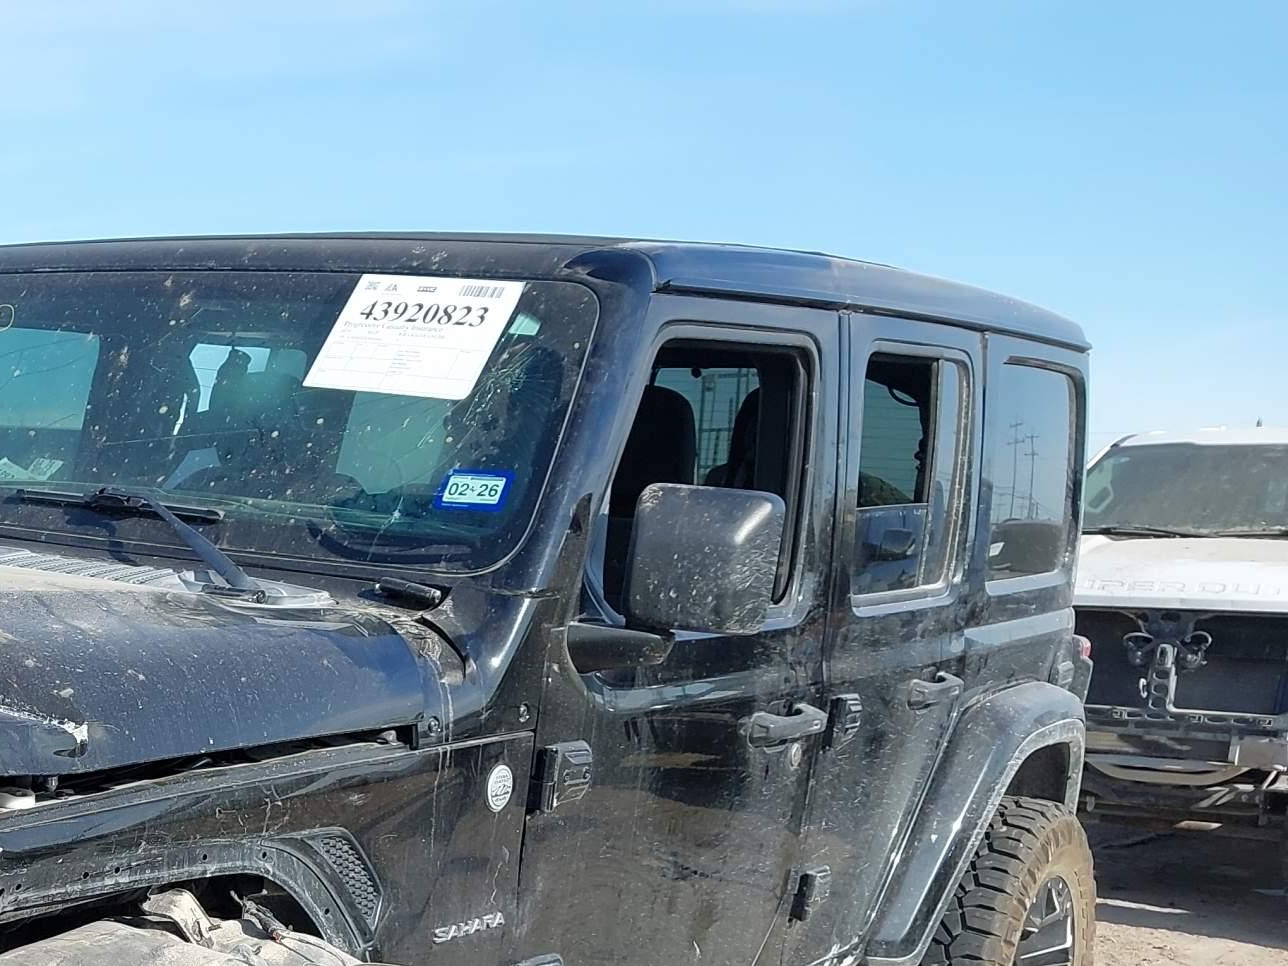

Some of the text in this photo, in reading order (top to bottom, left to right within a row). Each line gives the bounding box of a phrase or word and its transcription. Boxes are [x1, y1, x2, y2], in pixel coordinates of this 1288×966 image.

[359, 300, 489, 327] 43920823
[448, 482, 500, 497] 02 26
[432, 911, 505, 944] SAHARA
